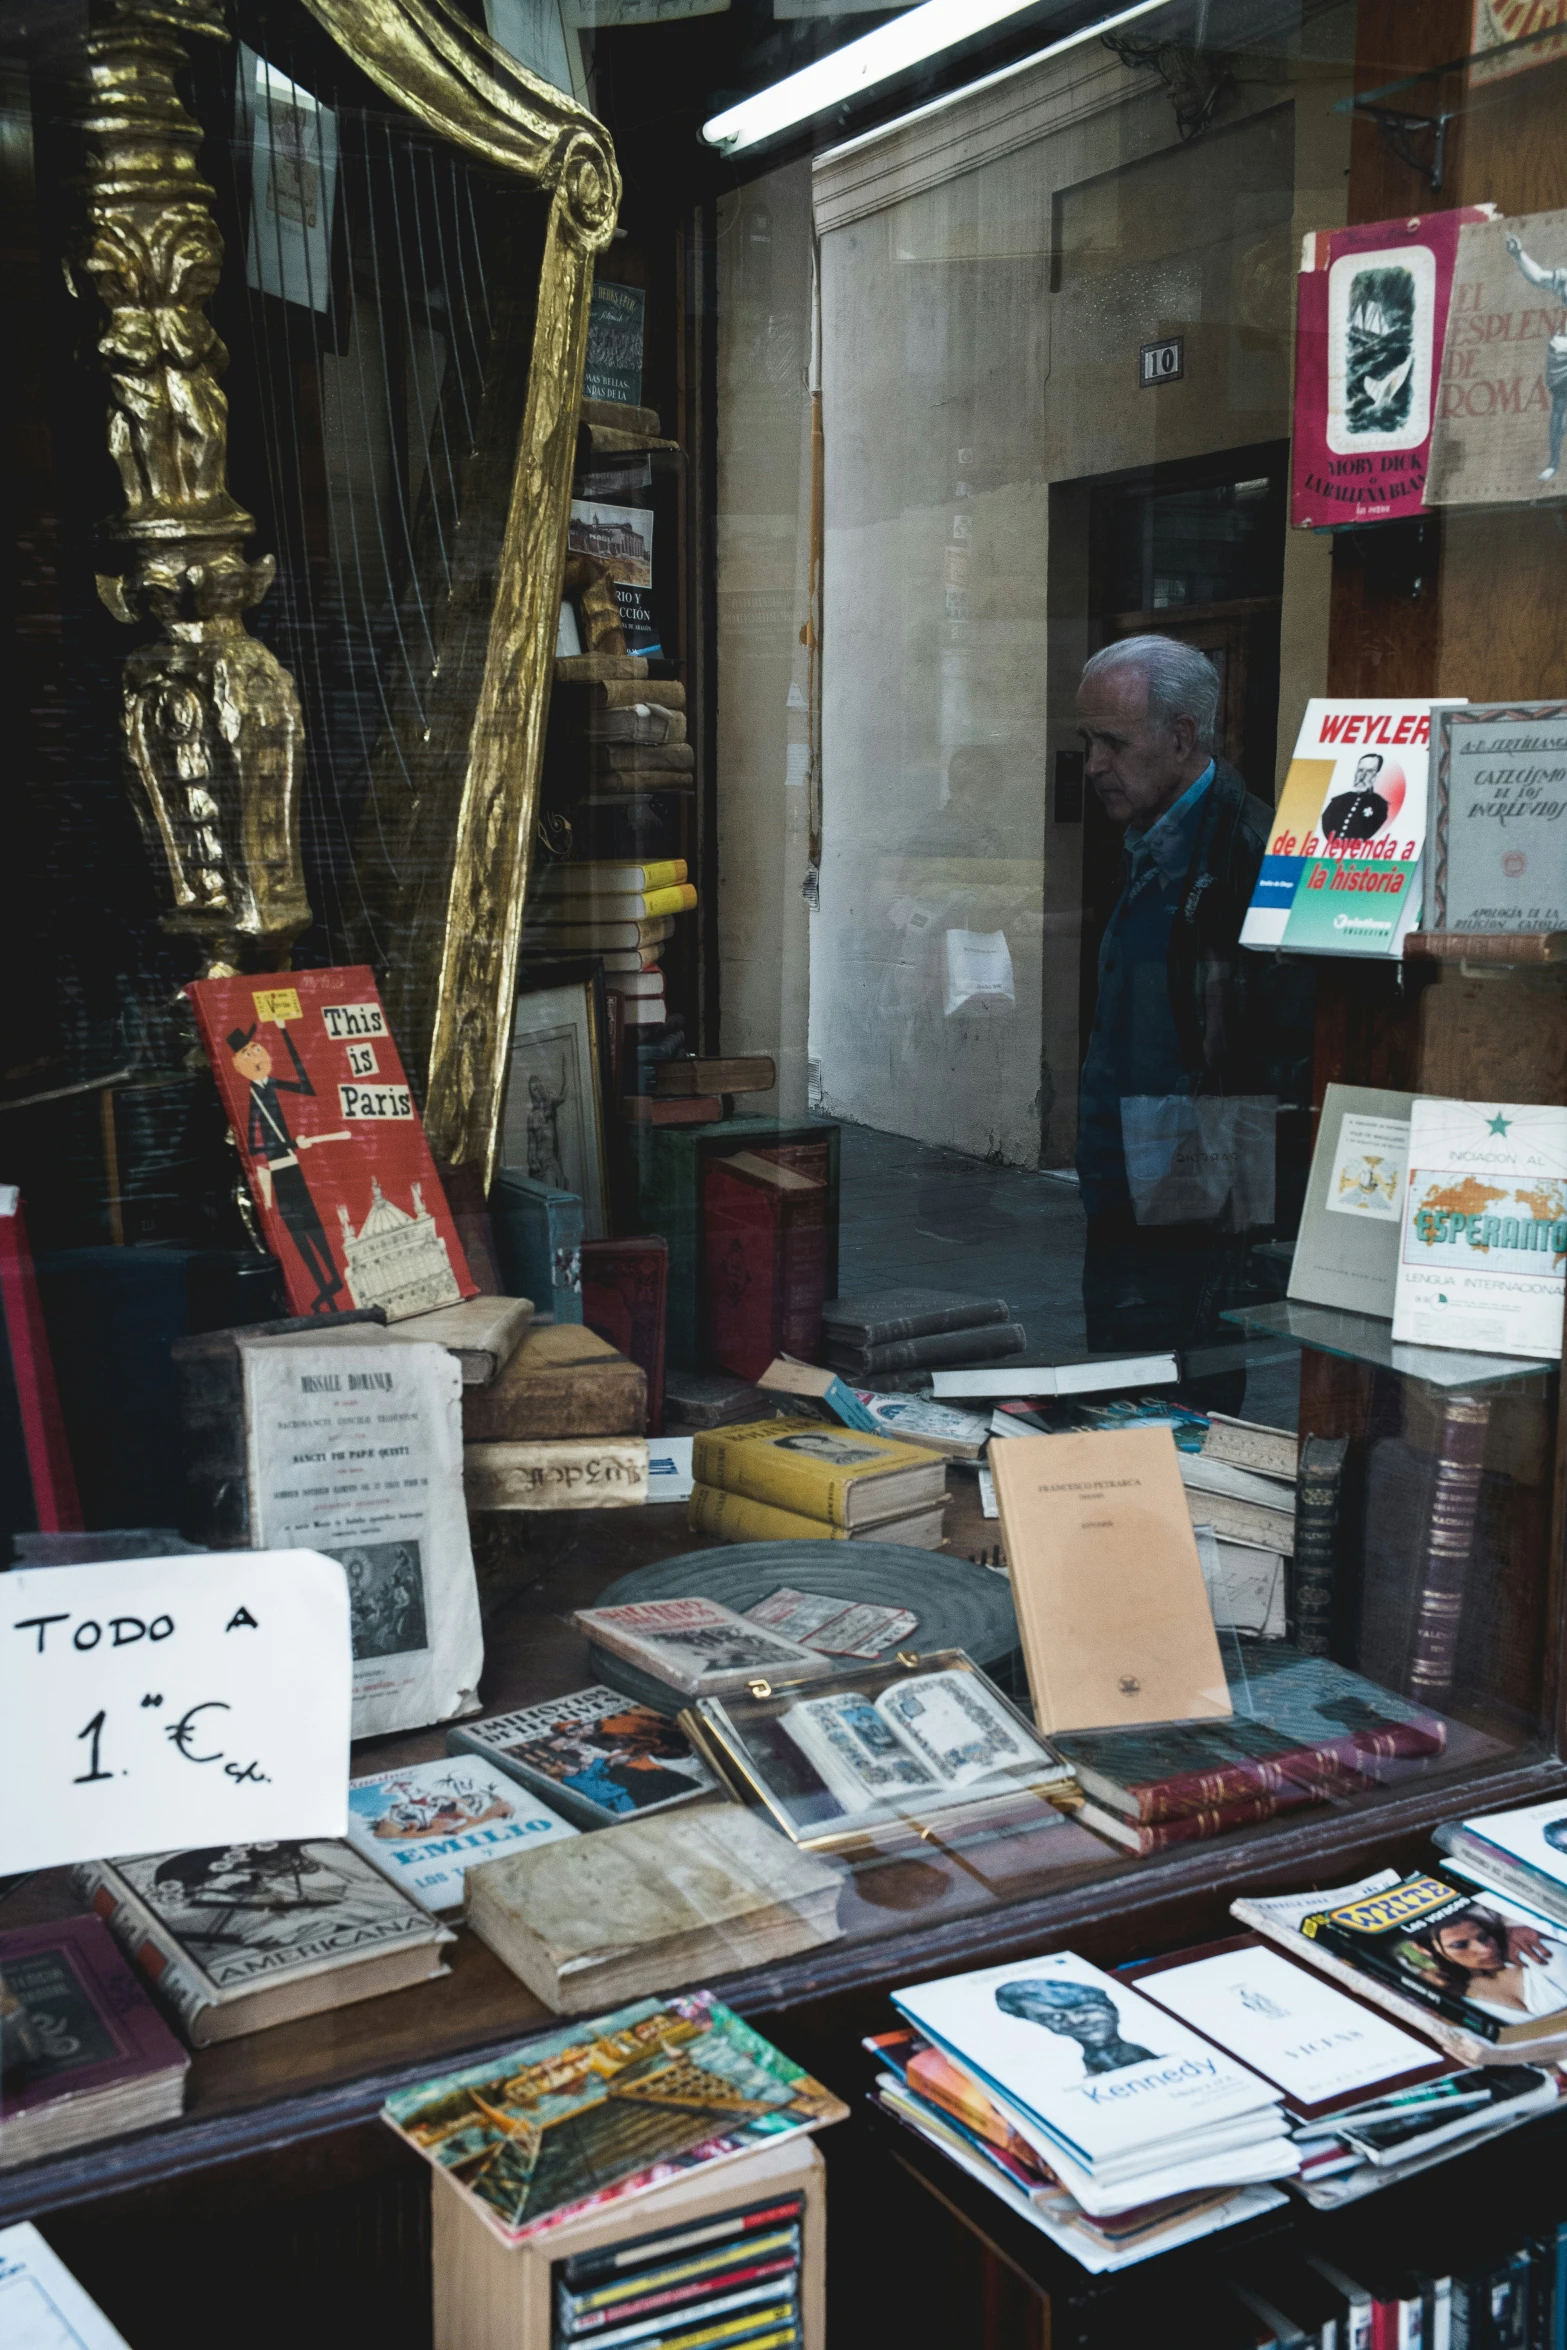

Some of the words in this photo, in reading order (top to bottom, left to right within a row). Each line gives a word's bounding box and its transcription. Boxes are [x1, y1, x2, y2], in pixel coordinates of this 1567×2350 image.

[1150, 347, 1175, 377] 10
[1447, 350, 1480, 380] DE
[1441, 374, 1553, 419] ROMA
[1328, 457, 1373, 477] MOBY
[1380, 453, 1422, 473] DICK
[634, 593, 642, 605] Y
[1271, 829, 1297, 856] de
[1300, 830, 1320, 857] la
[1321, 829, 1399, 864] leyenda
[1400, 839, 1416, 861] a
[1306, 862, 1329, 890] la
[1329, 863, 1406, 895] historia
[323, 1008, 382, 1037] This
[350, 1048, 371, 1076] is
[340, 1087, 411, 1117] Paris
[1416, 1209, 1567, 1254] ESPERANTO
[1405, 1271, 1456, 1286] LENGUA
[13, 1612, 176, 1655] TODO
[225, 1605, 259, 1633] A
[482, 1696, 622, 1744] DETECTIVES
[391, 1818, 554, 1866] EMILIO
[413, 1871, 449, 1889] LOS
[1337, 1880, 1452, 1928] WHITE
[217, 1912, 433, 1984] AMERICANA
[1081, 2057, 1218, 2105] Kennedy
